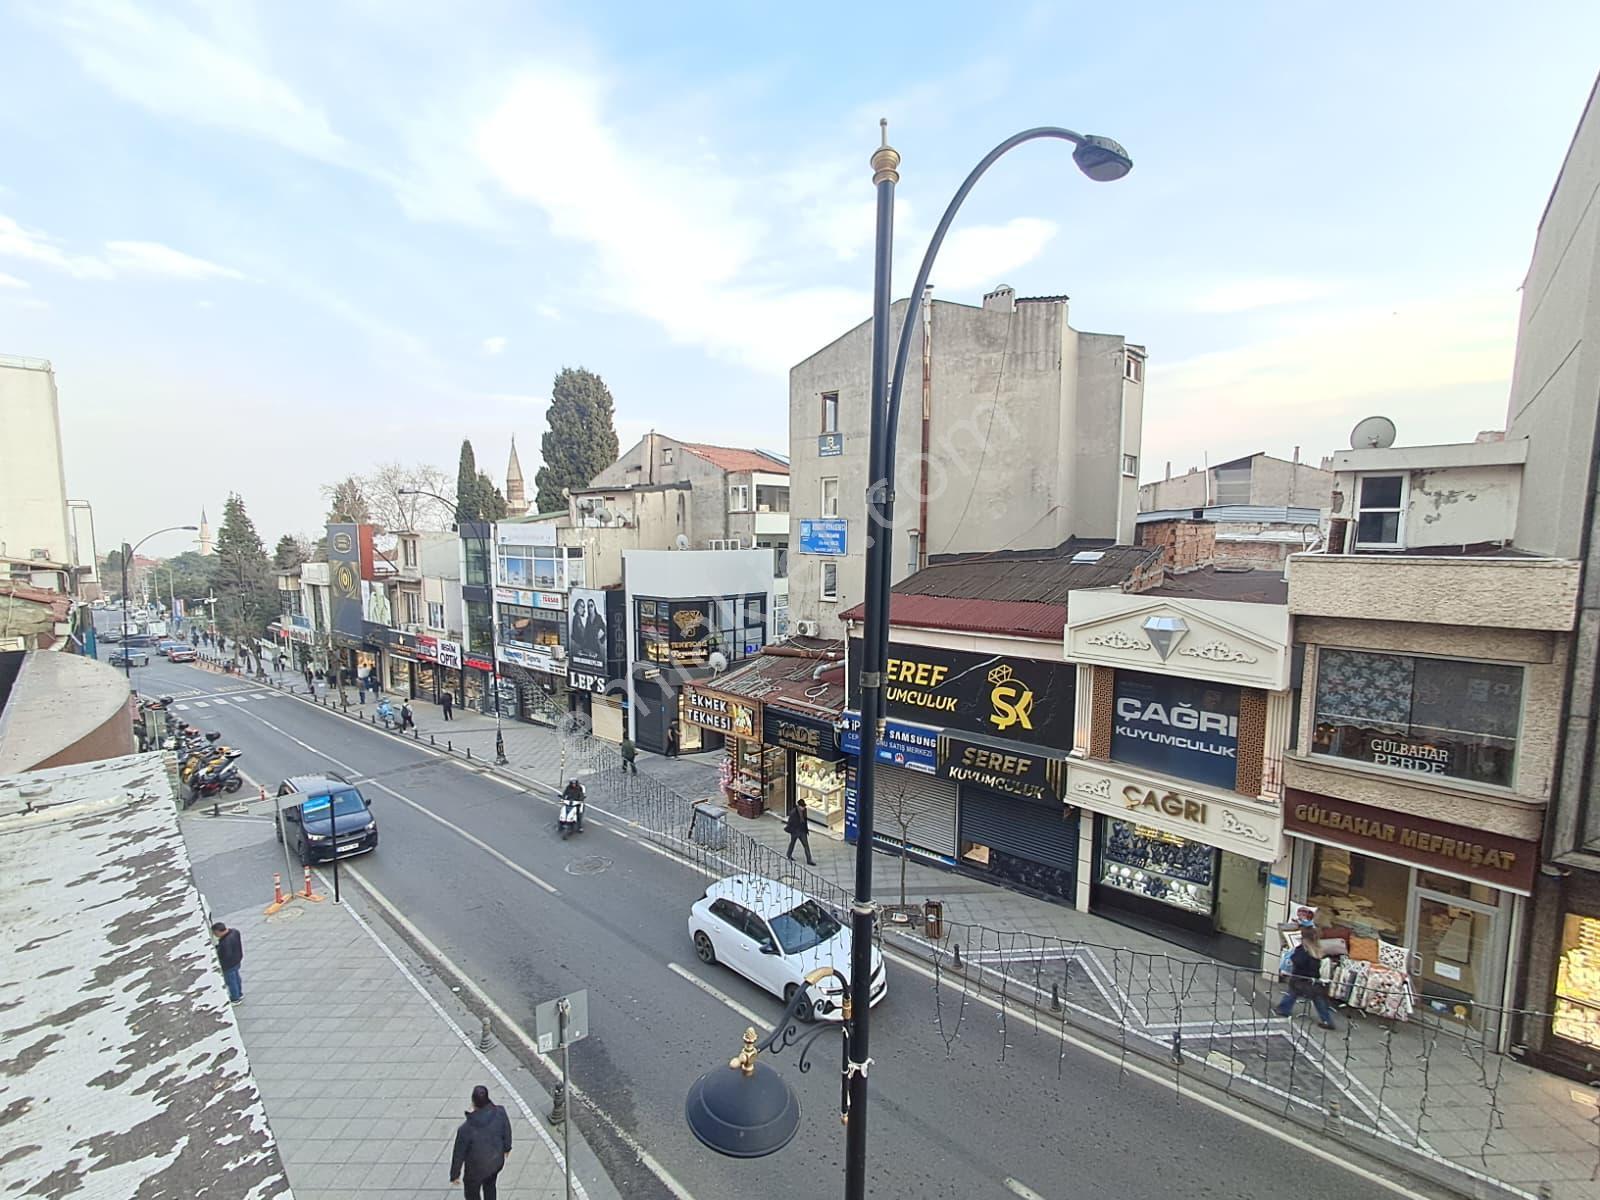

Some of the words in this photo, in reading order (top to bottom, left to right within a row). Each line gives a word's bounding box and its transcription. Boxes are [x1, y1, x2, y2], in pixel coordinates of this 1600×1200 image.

[570, 671, 605, 693] LEP'S
[887, 658, 948, 687] EREF
[691, 693, 727, 713] EKMEK
[886, 686, 958, 712] UMCULUK
[1116, 697, 1238, 738] ÇAĞRI
[889, 730, 937, 748] SAMSUNG
[1115, 725, 1237, 759] KUYUMCULUK
[949, 765, 1045, 800] KUYUMCULUK
[1122, 785, 1207, 825] ÇAĞRI
[1294, 803, 1396, 842] GÜLBAHAR
[1400, 828, 1516, 870] MEFRUŞAT
